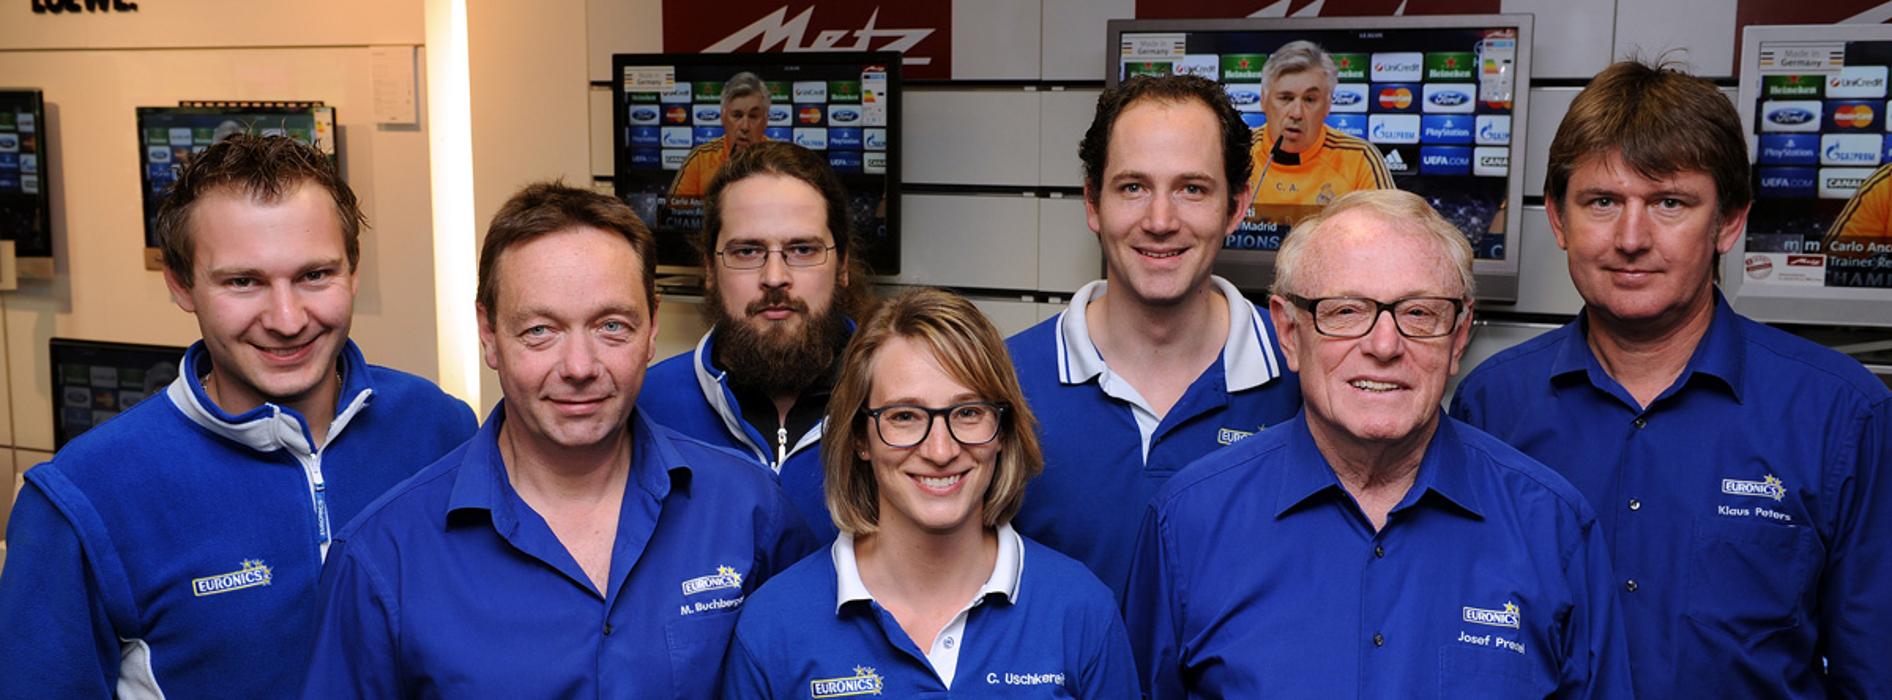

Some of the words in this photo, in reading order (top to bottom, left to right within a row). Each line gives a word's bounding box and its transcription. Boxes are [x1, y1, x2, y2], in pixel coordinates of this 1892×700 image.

[700, 5, 936, 53] Metz
[1137, 48, 1169, 56] Germany
[1784, 49, 1807, 57] Made
[1384, 63, 1420, 72] UniCredit
[1780, 59, 1822, 67] Germany
[1428, 69, 1471, 78] Heineken
[1841, 78, 1883, 88] UniCredit
[1770, 85, 1817, 95] Heineken
[1434, 94, 1461, 106] Ford
[1775, 110, 1806, 122] Ford
[1424, 127, 1470, 138] PlayStation
[1764, 148, 1814, 158] PlayStation
[1423, 155, 1470, 166] UEFA.COM
[1481, 156, 1508, 167] CANA
[1240, 221, 1278, 232] Madrid
[1225, 235, 1281, 249] PIONS
[1829, 240, 1864, 252] Carlo
[1829, 256, 1873, 267] Trainer
[1726, 482, 1776, 496] EURONICS
[1718, 505, 1750, 516] Klaus
[1755, 507, 1791, 521] Peters
[198, 569, 263, 592] EURONICS
[685, 576, 735, 592] EURONICS
[680, 605, 694, 616] M.
[1465, 609, 1519, 625] EURONICS
[1458, 631, 1491, 646] Josef
[986, 672, 1000, 684] C.
[814, 678, 873, 695] EURONICS
